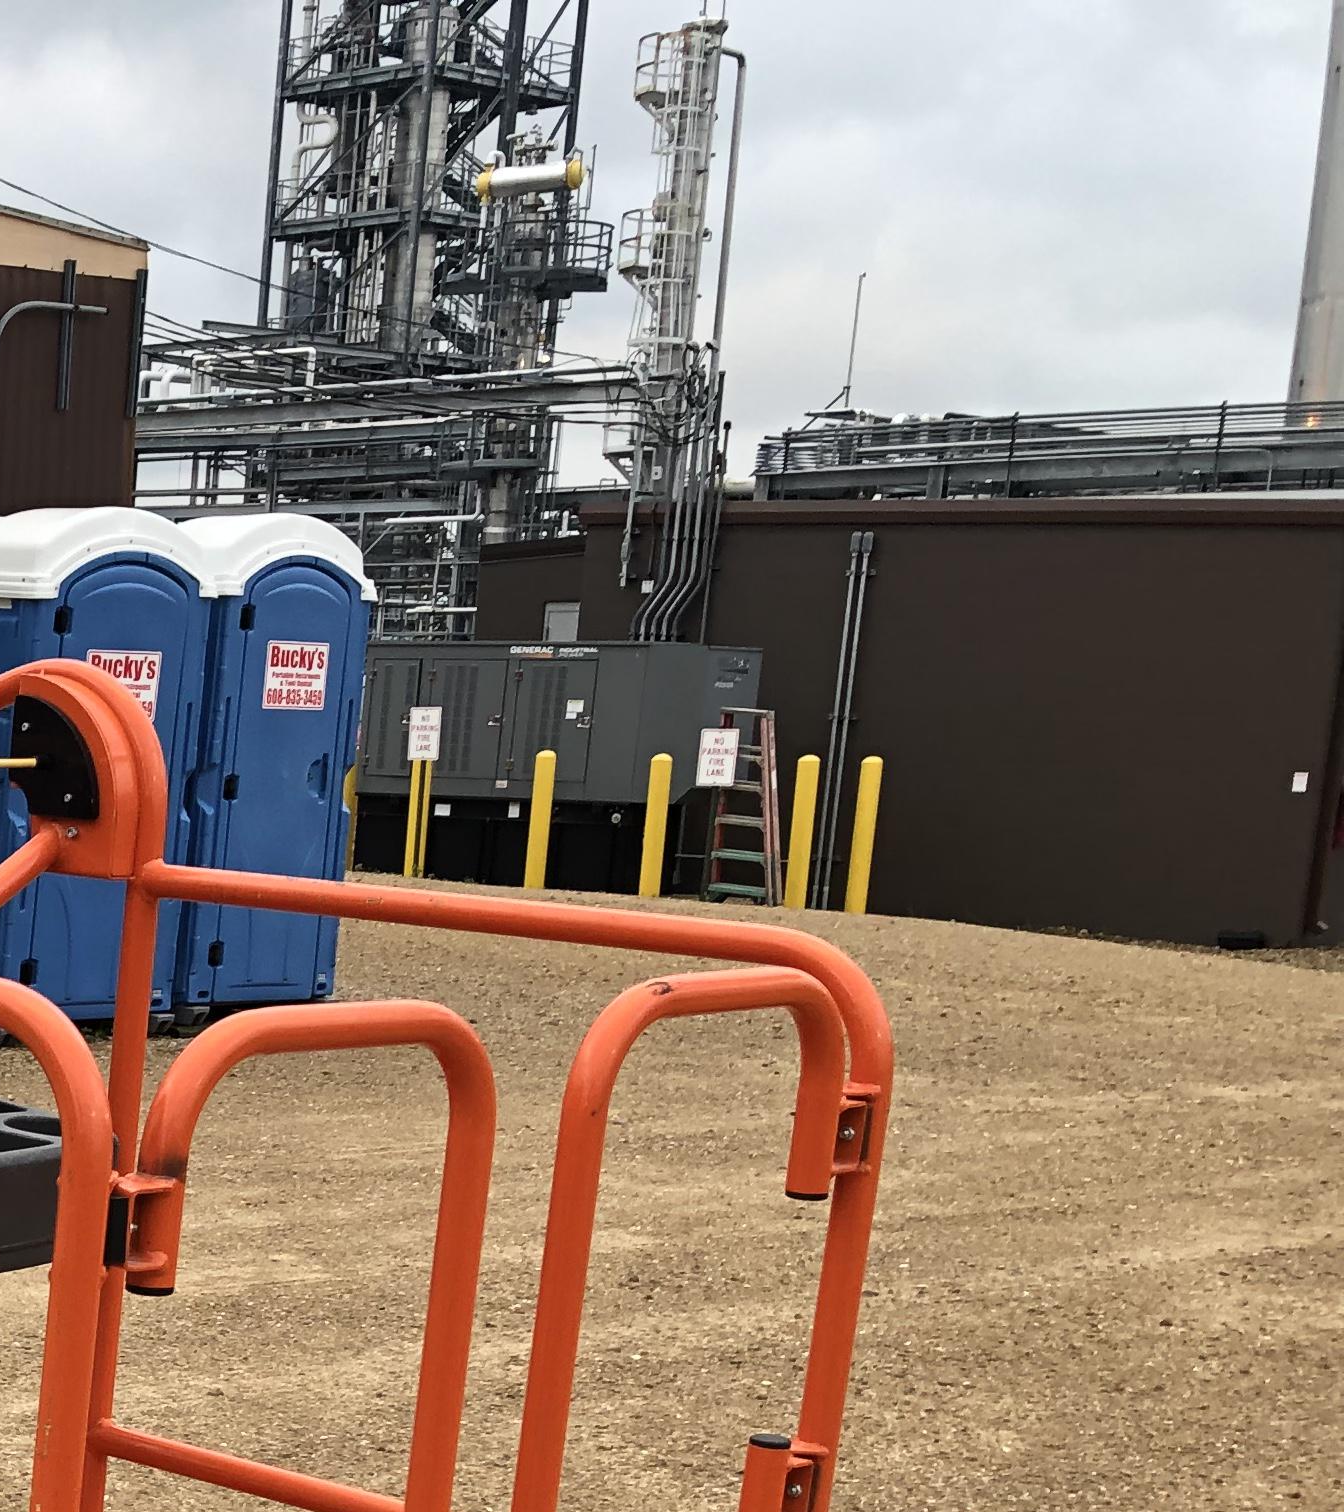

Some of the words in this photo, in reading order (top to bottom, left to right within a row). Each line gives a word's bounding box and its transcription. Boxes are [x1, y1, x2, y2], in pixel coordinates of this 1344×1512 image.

[510, 645, 553, 654] GENERAC
[270, 645, 325, 671] Bucky's
[714, 737, 725, 746] NO
[701, 747, 736, 756] PARKING
[705, 768, 725, 777] LANE
